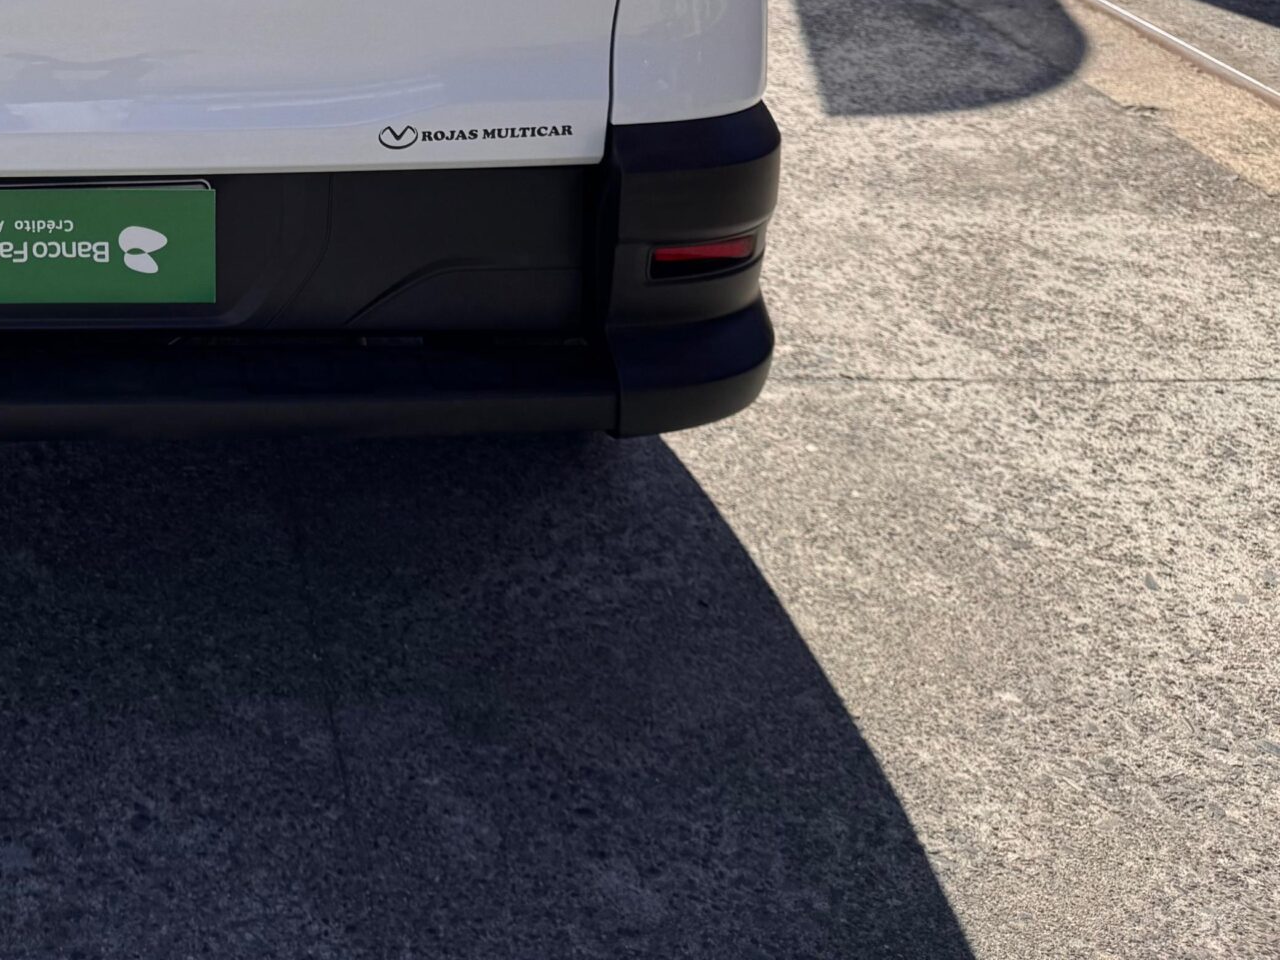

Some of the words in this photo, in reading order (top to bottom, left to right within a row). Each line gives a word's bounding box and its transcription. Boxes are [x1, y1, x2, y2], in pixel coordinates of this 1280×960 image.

[421, 129, 478, 141] ROJAS
[482, 125, 573, 139] MULTICAR
[14, 219, 74, 233] Crédito
[32, 241, 110, 263] Banco
